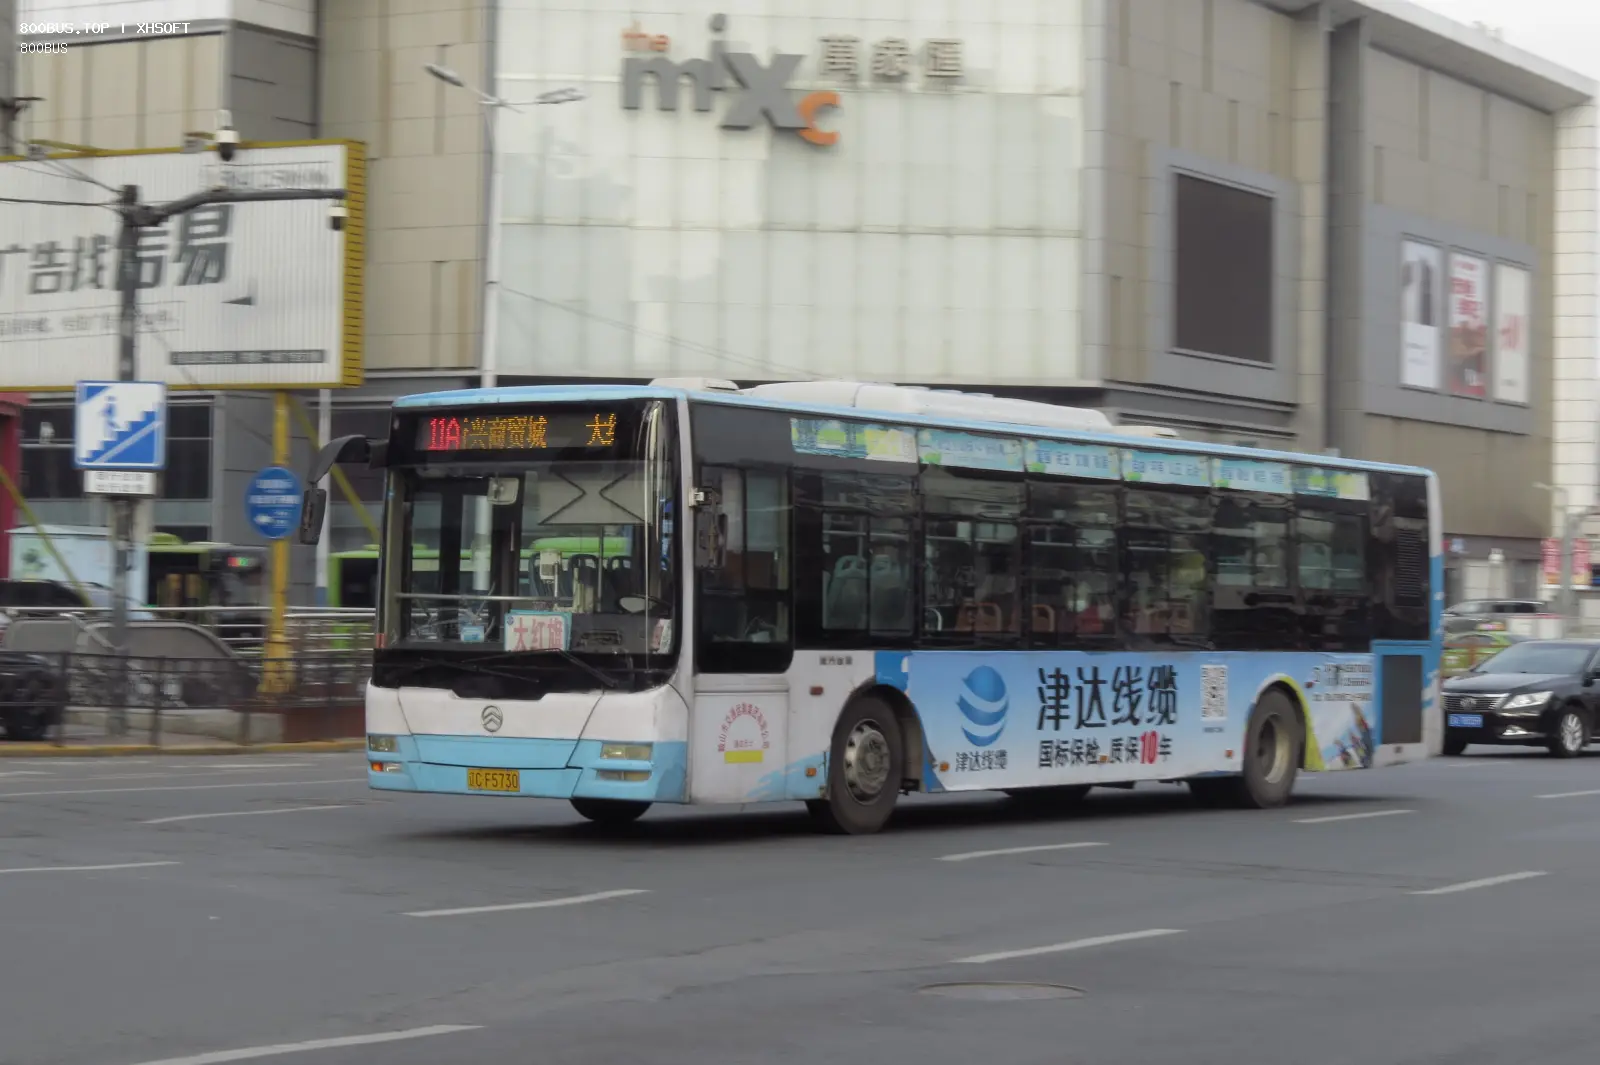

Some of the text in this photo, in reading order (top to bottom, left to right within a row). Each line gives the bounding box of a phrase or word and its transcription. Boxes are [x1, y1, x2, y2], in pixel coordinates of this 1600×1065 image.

[1036, 664, 1178, 731] 津达线缆
[955, 750, 1008, 772] 津达线缆
